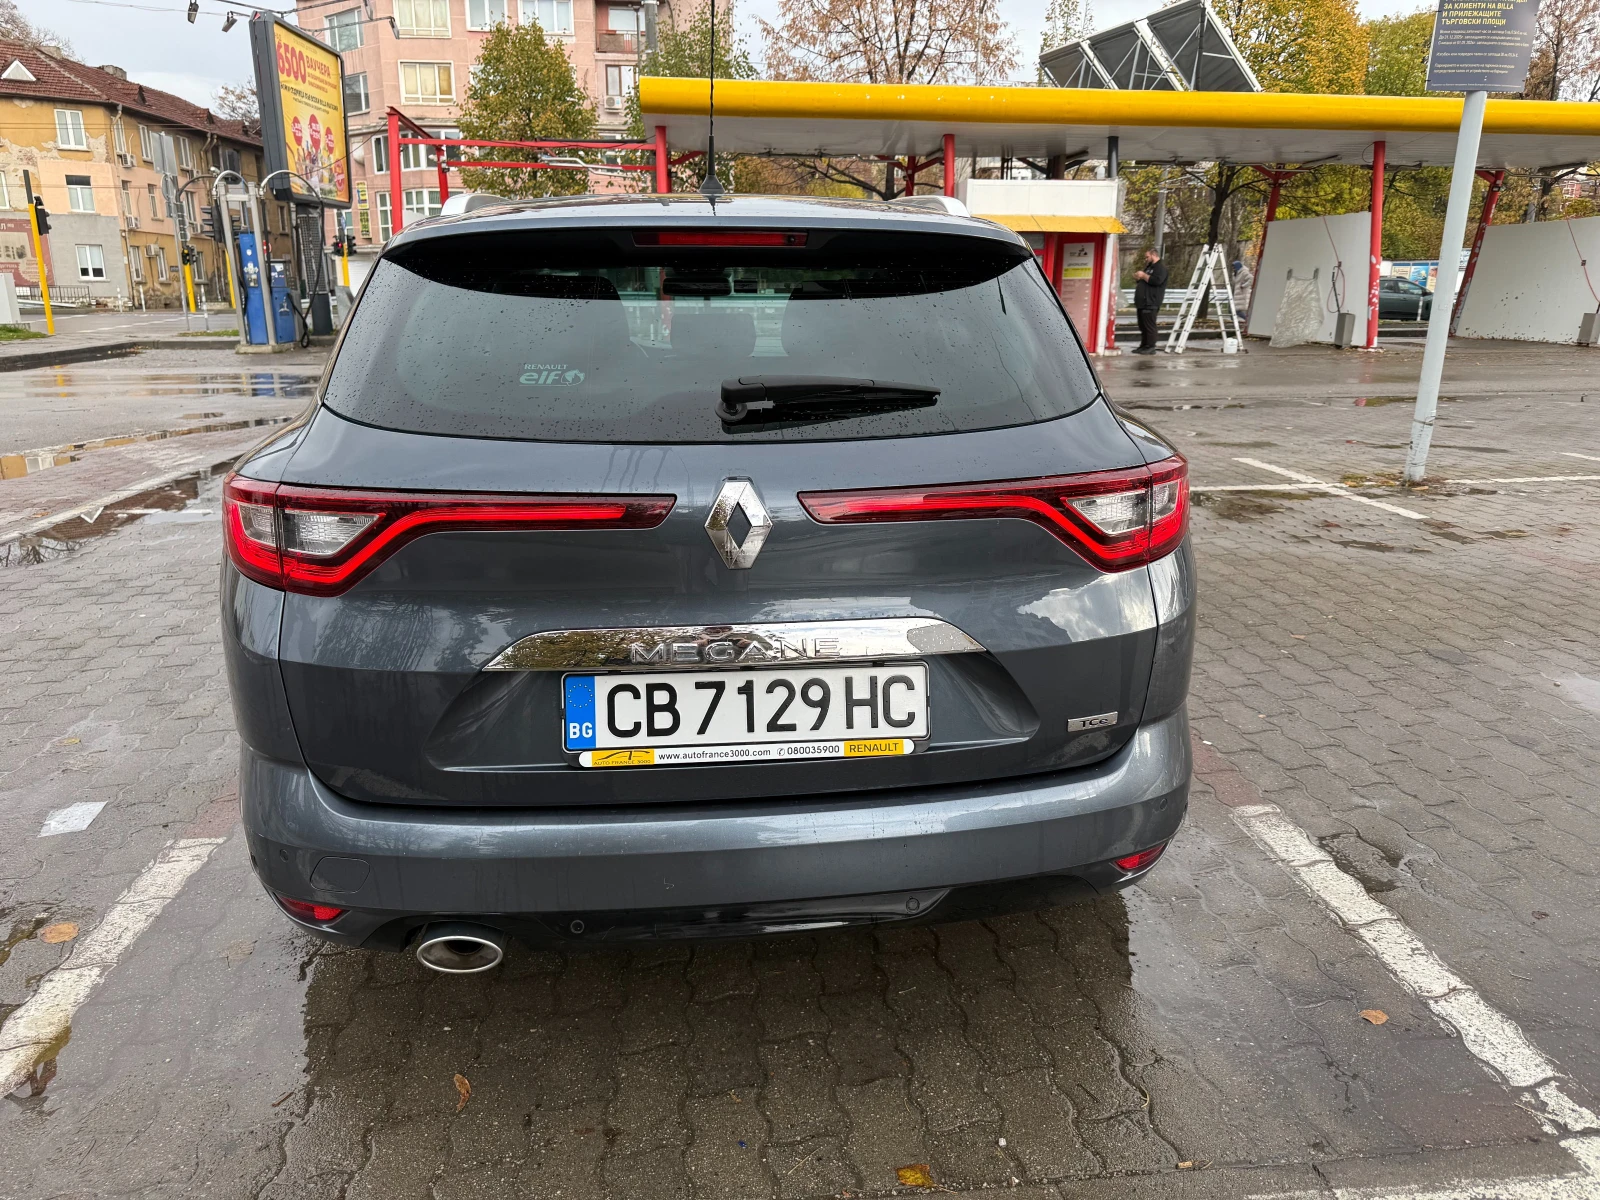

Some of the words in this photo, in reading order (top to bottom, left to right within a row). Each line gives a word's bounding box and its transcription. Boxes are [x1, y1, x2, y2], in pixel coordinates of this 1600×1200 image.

[1449, 10, 1502, 18] ПРИЛЕЖАЩИТЕ
[1482, 18, 1507, 26] ПЛОЩИ
[276, 40, 307, 84] 6500
[305, 55, 332, 79] ВАУЧЕРА
[519, 370, 562, 384] elf
[631, 637, 841, 664] MEGANE
[606, 682, 681, 738] CB
[694, 677, 831, 735] 7129
[844, 674, 916, 730] HC
[569, 722, 593, 739] BG
[658, 748, 771, 761] www.autofrance3000.com
[787, 744, 840, 755] 080035900
[849, 742, 900, 753] RENAULT
